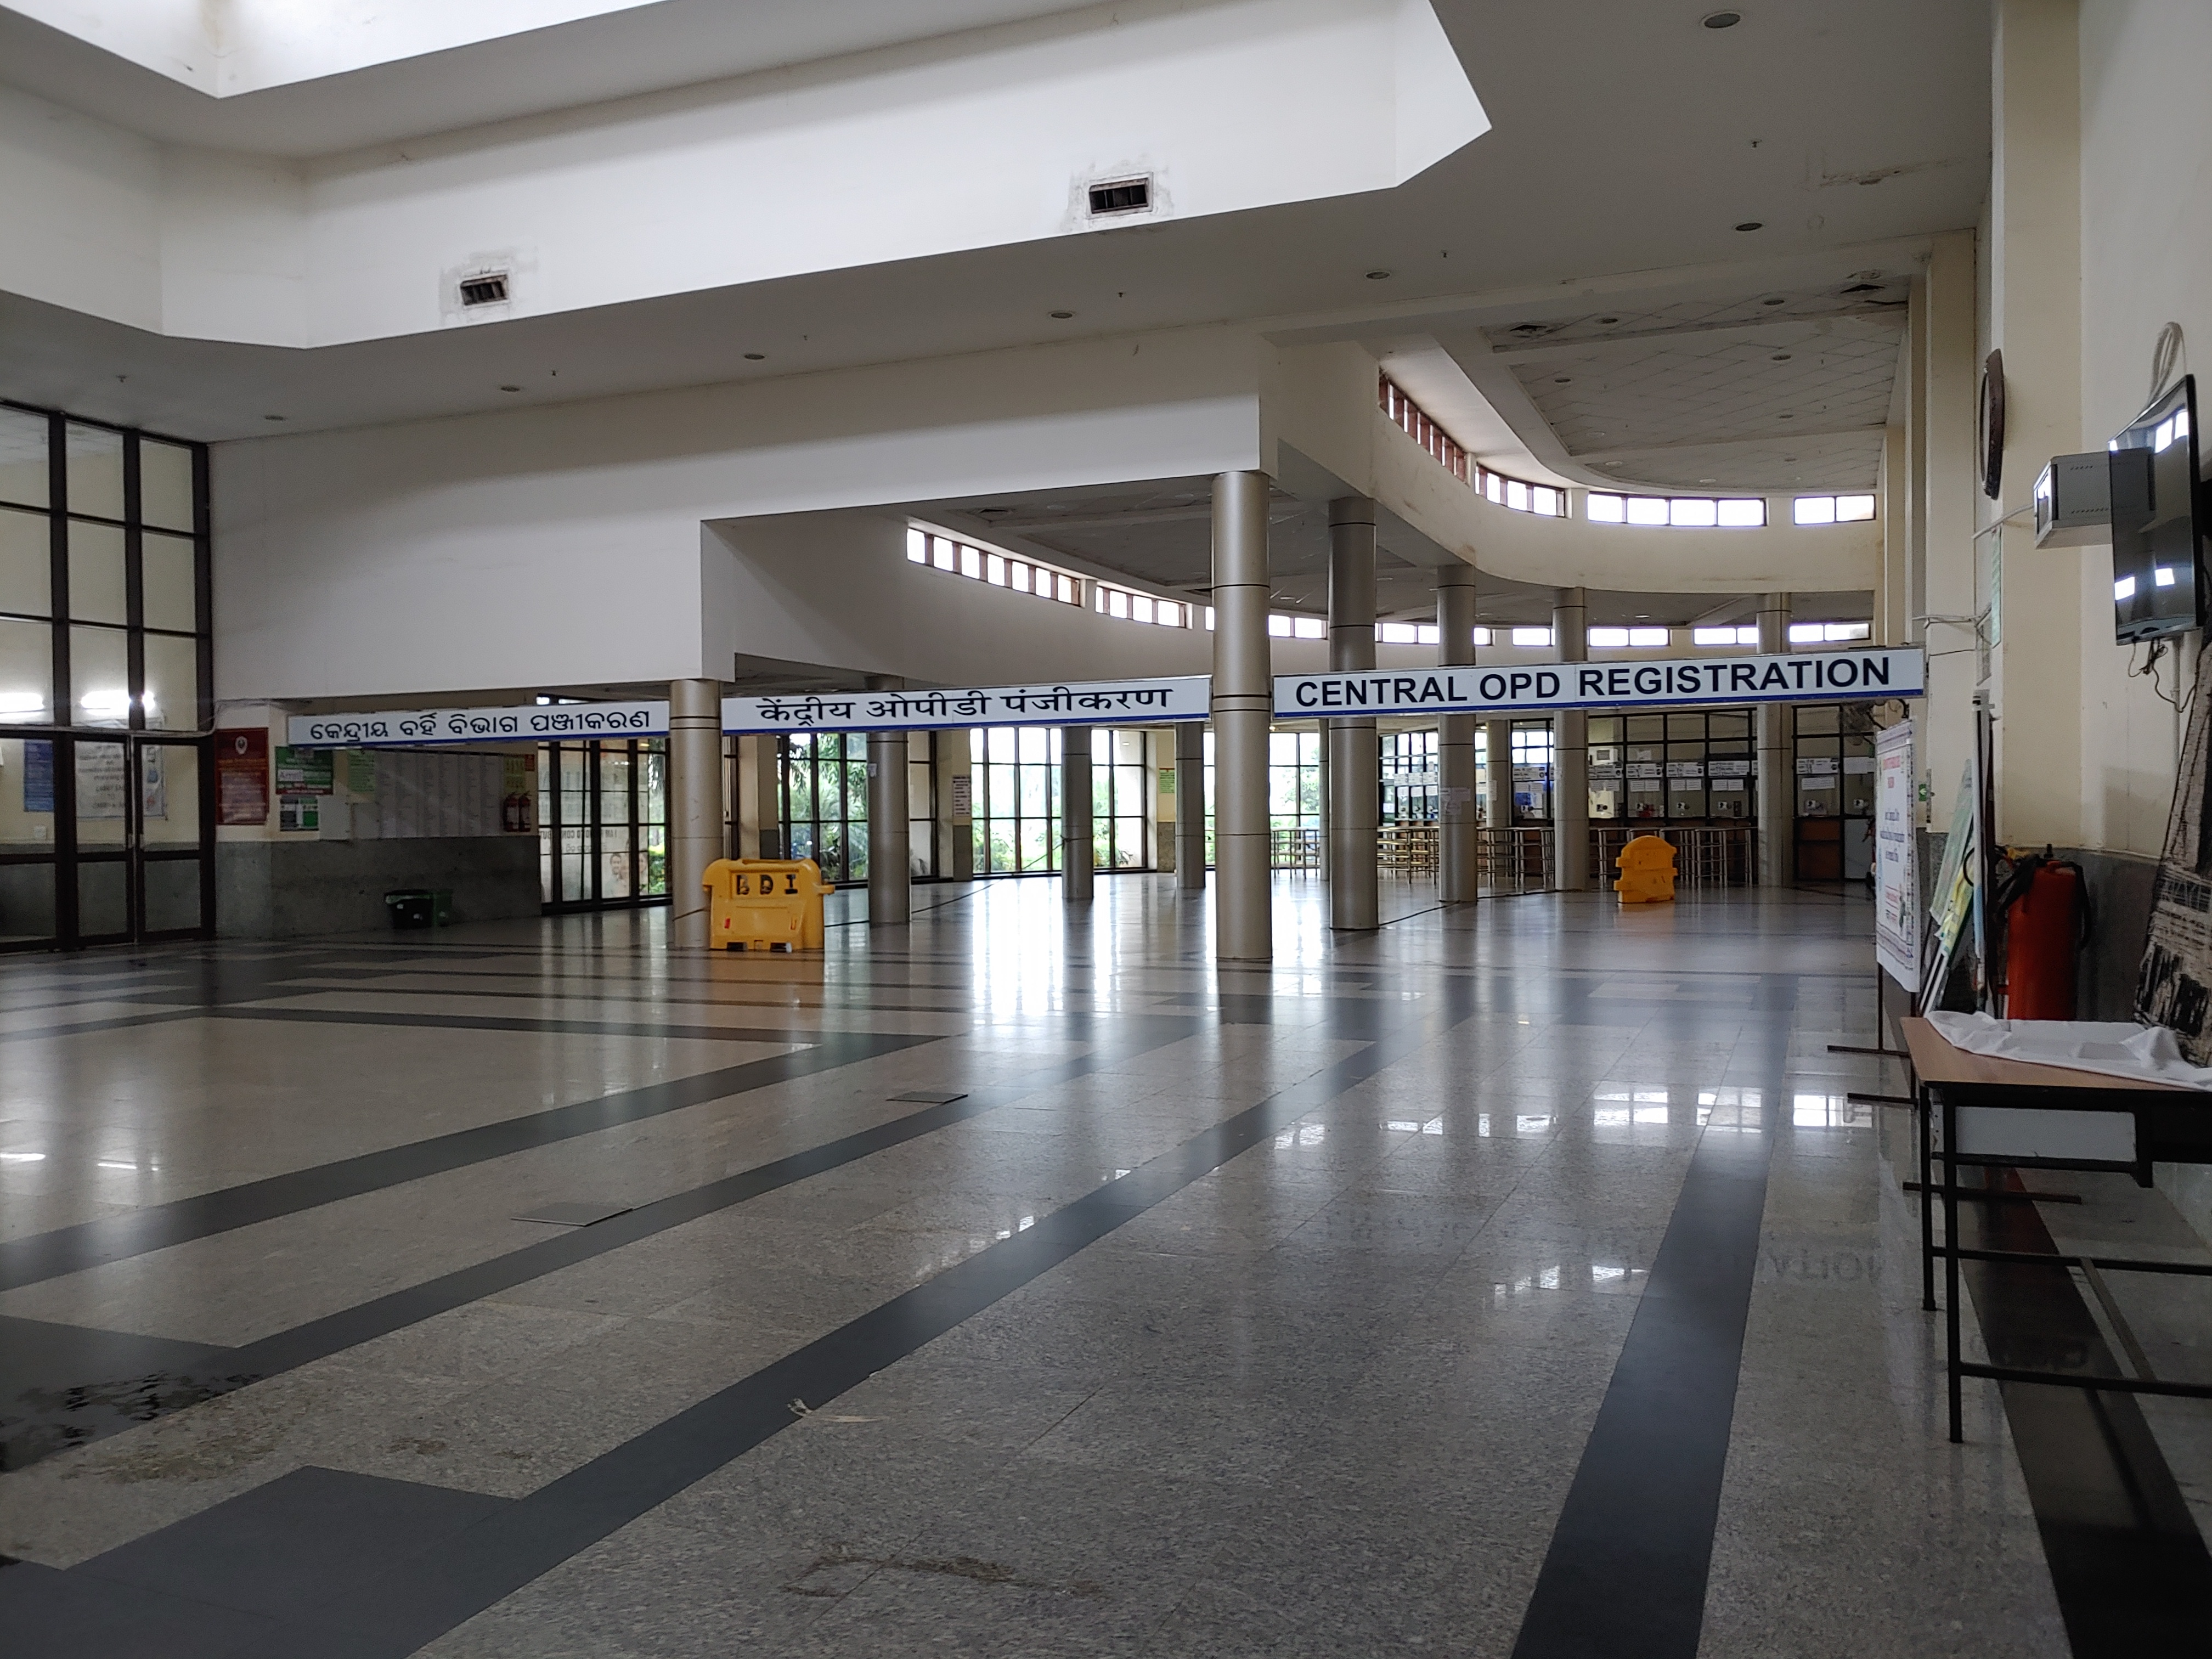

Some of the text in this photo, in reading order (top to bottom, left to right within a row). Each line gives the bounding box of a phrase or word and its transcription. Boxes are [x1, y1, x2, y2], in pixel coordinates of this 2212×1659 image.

[1296, 657, 1889, 707] CENTRAL OPD REGISTRATION
[448, 713, 518, 735] ବିଭାଗ
[530, 710, 650, 731] ପଞ୍ଜୀକରଣ
[756, 686, 1174, 726] केंद्रीय ओपीडी पंजीकरण
